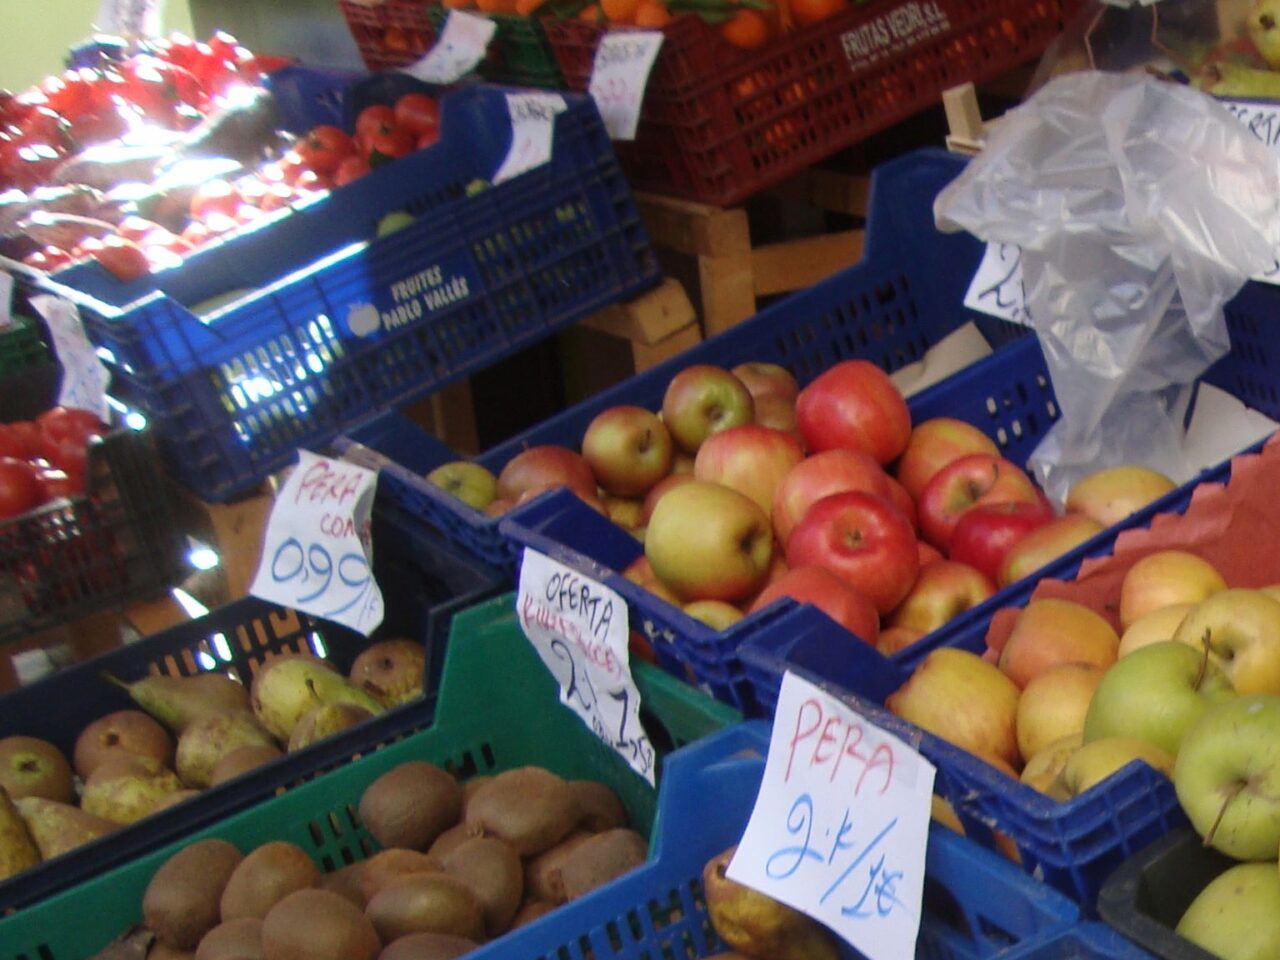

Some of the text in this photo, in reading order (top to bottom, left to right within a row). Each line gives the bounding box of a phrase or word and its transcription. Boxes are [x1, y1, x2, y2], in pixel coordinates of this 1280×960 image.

[382, 298, 422, 331] PABLO
[545, 572, 614, 643] OFERTA
[784, 698, 895, 796] PERA
